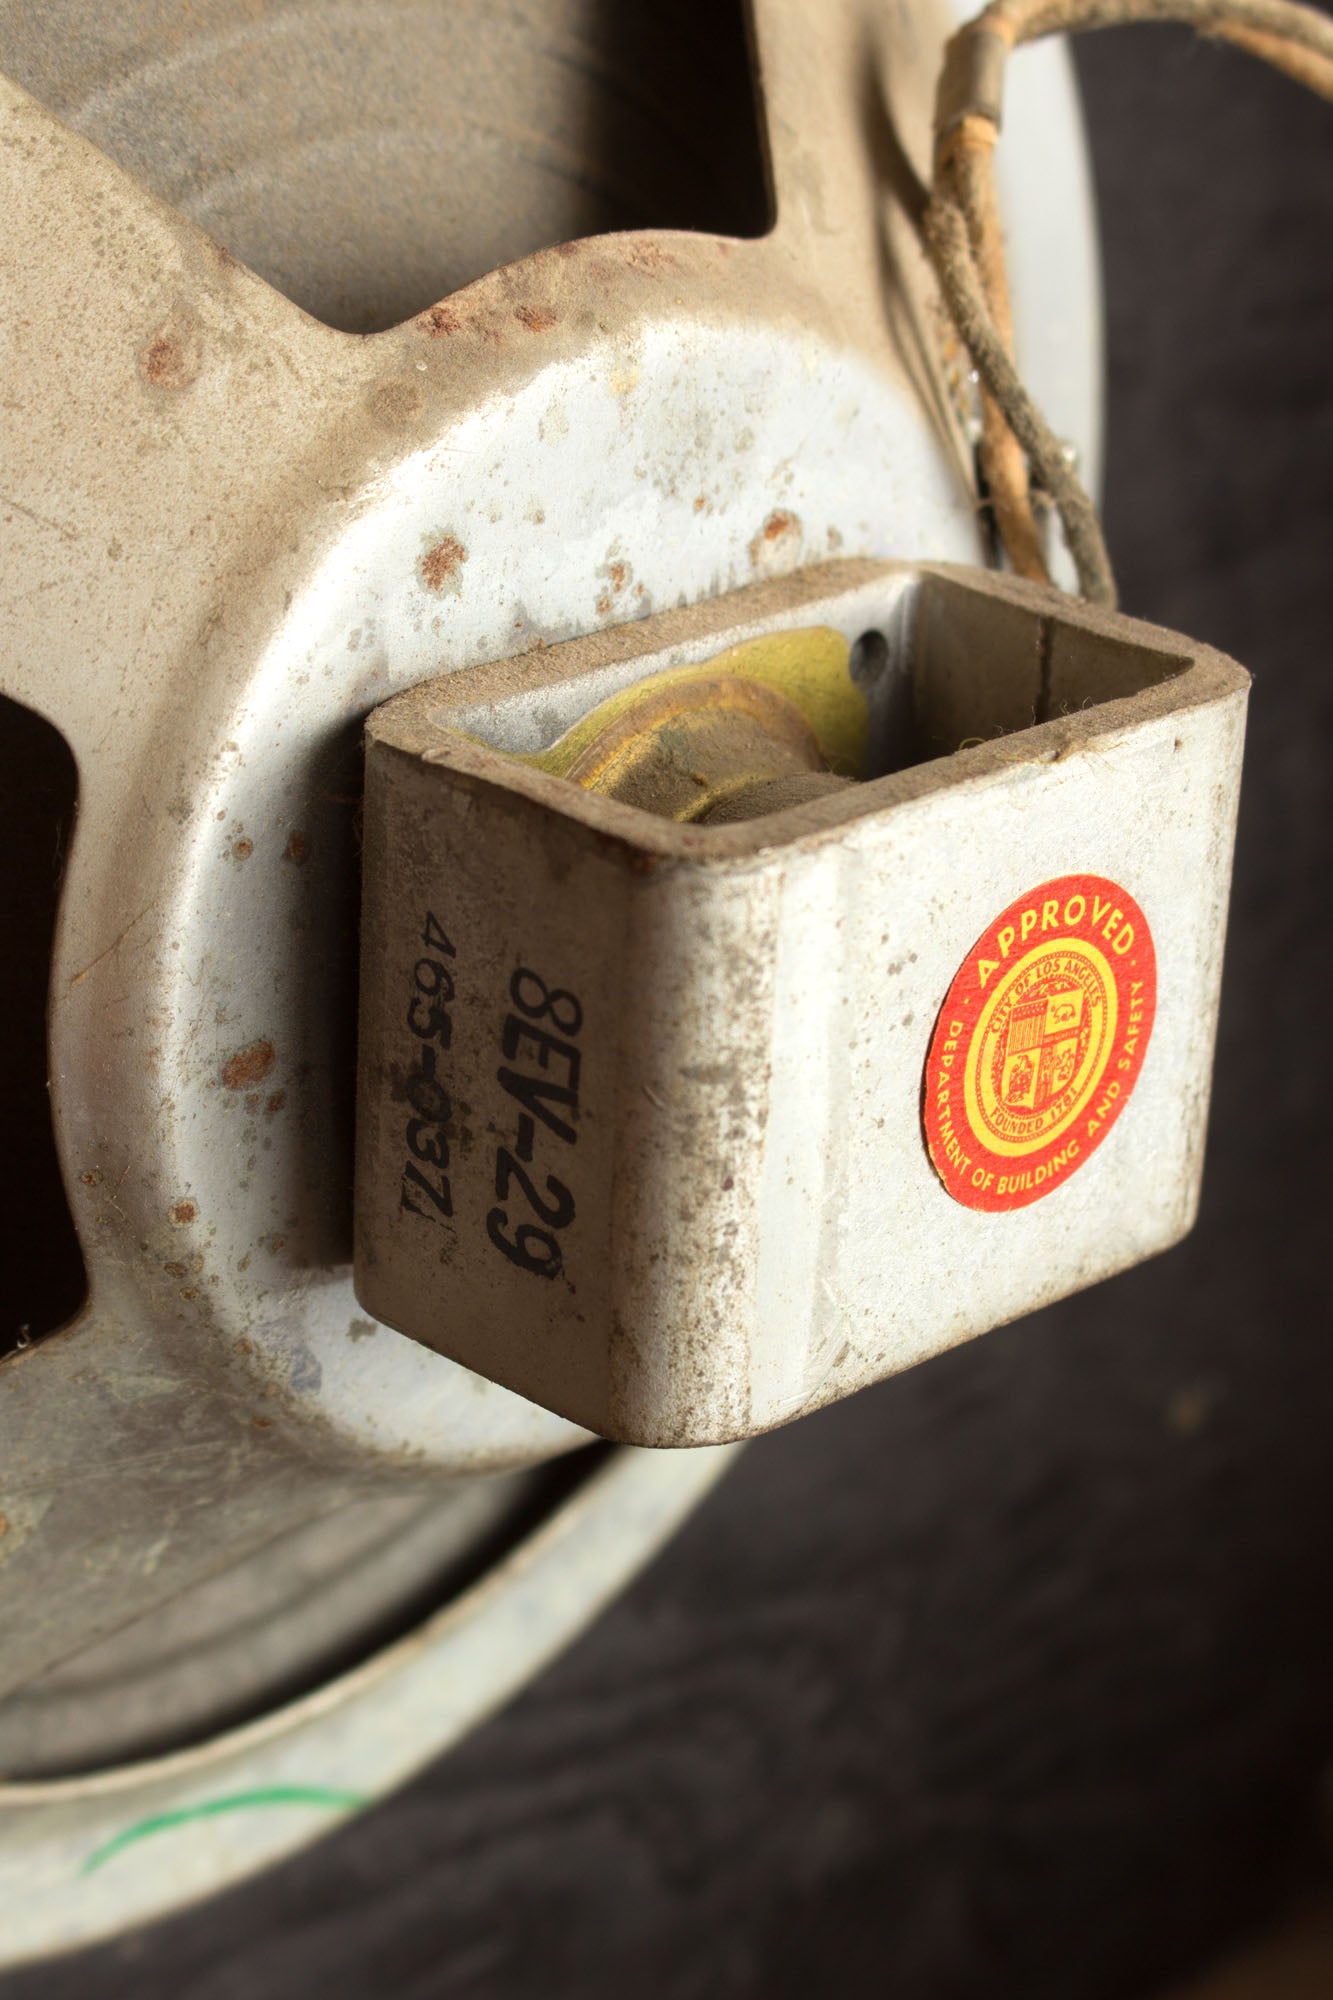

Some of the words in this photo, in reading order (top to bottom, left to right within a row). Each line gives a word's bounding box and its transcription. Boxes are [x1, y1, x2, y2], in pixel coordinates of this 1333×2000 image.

[976, 894, 1134, 989] APPROVED
[991, 996, 1012, 1034] CITY
[1014, 973, 1031, 996] OF
[1036, 959, 1061, 978] LOS
[1064, 960, 1103, 1008] ANGELES
[486, 966, 584, 1280] 8EV-29
[937, 1020, 972, 1176] DEPARTMENT
[971, 1167, 994, 1192] OF
[997, 1139, 1080, 1195] BUILDING
[1087, 1081, 1121, 1138] AND
[1118, 980, 1144, 1071] SAFETY
[990, 1106, 1044, 1135] FOUNDED
